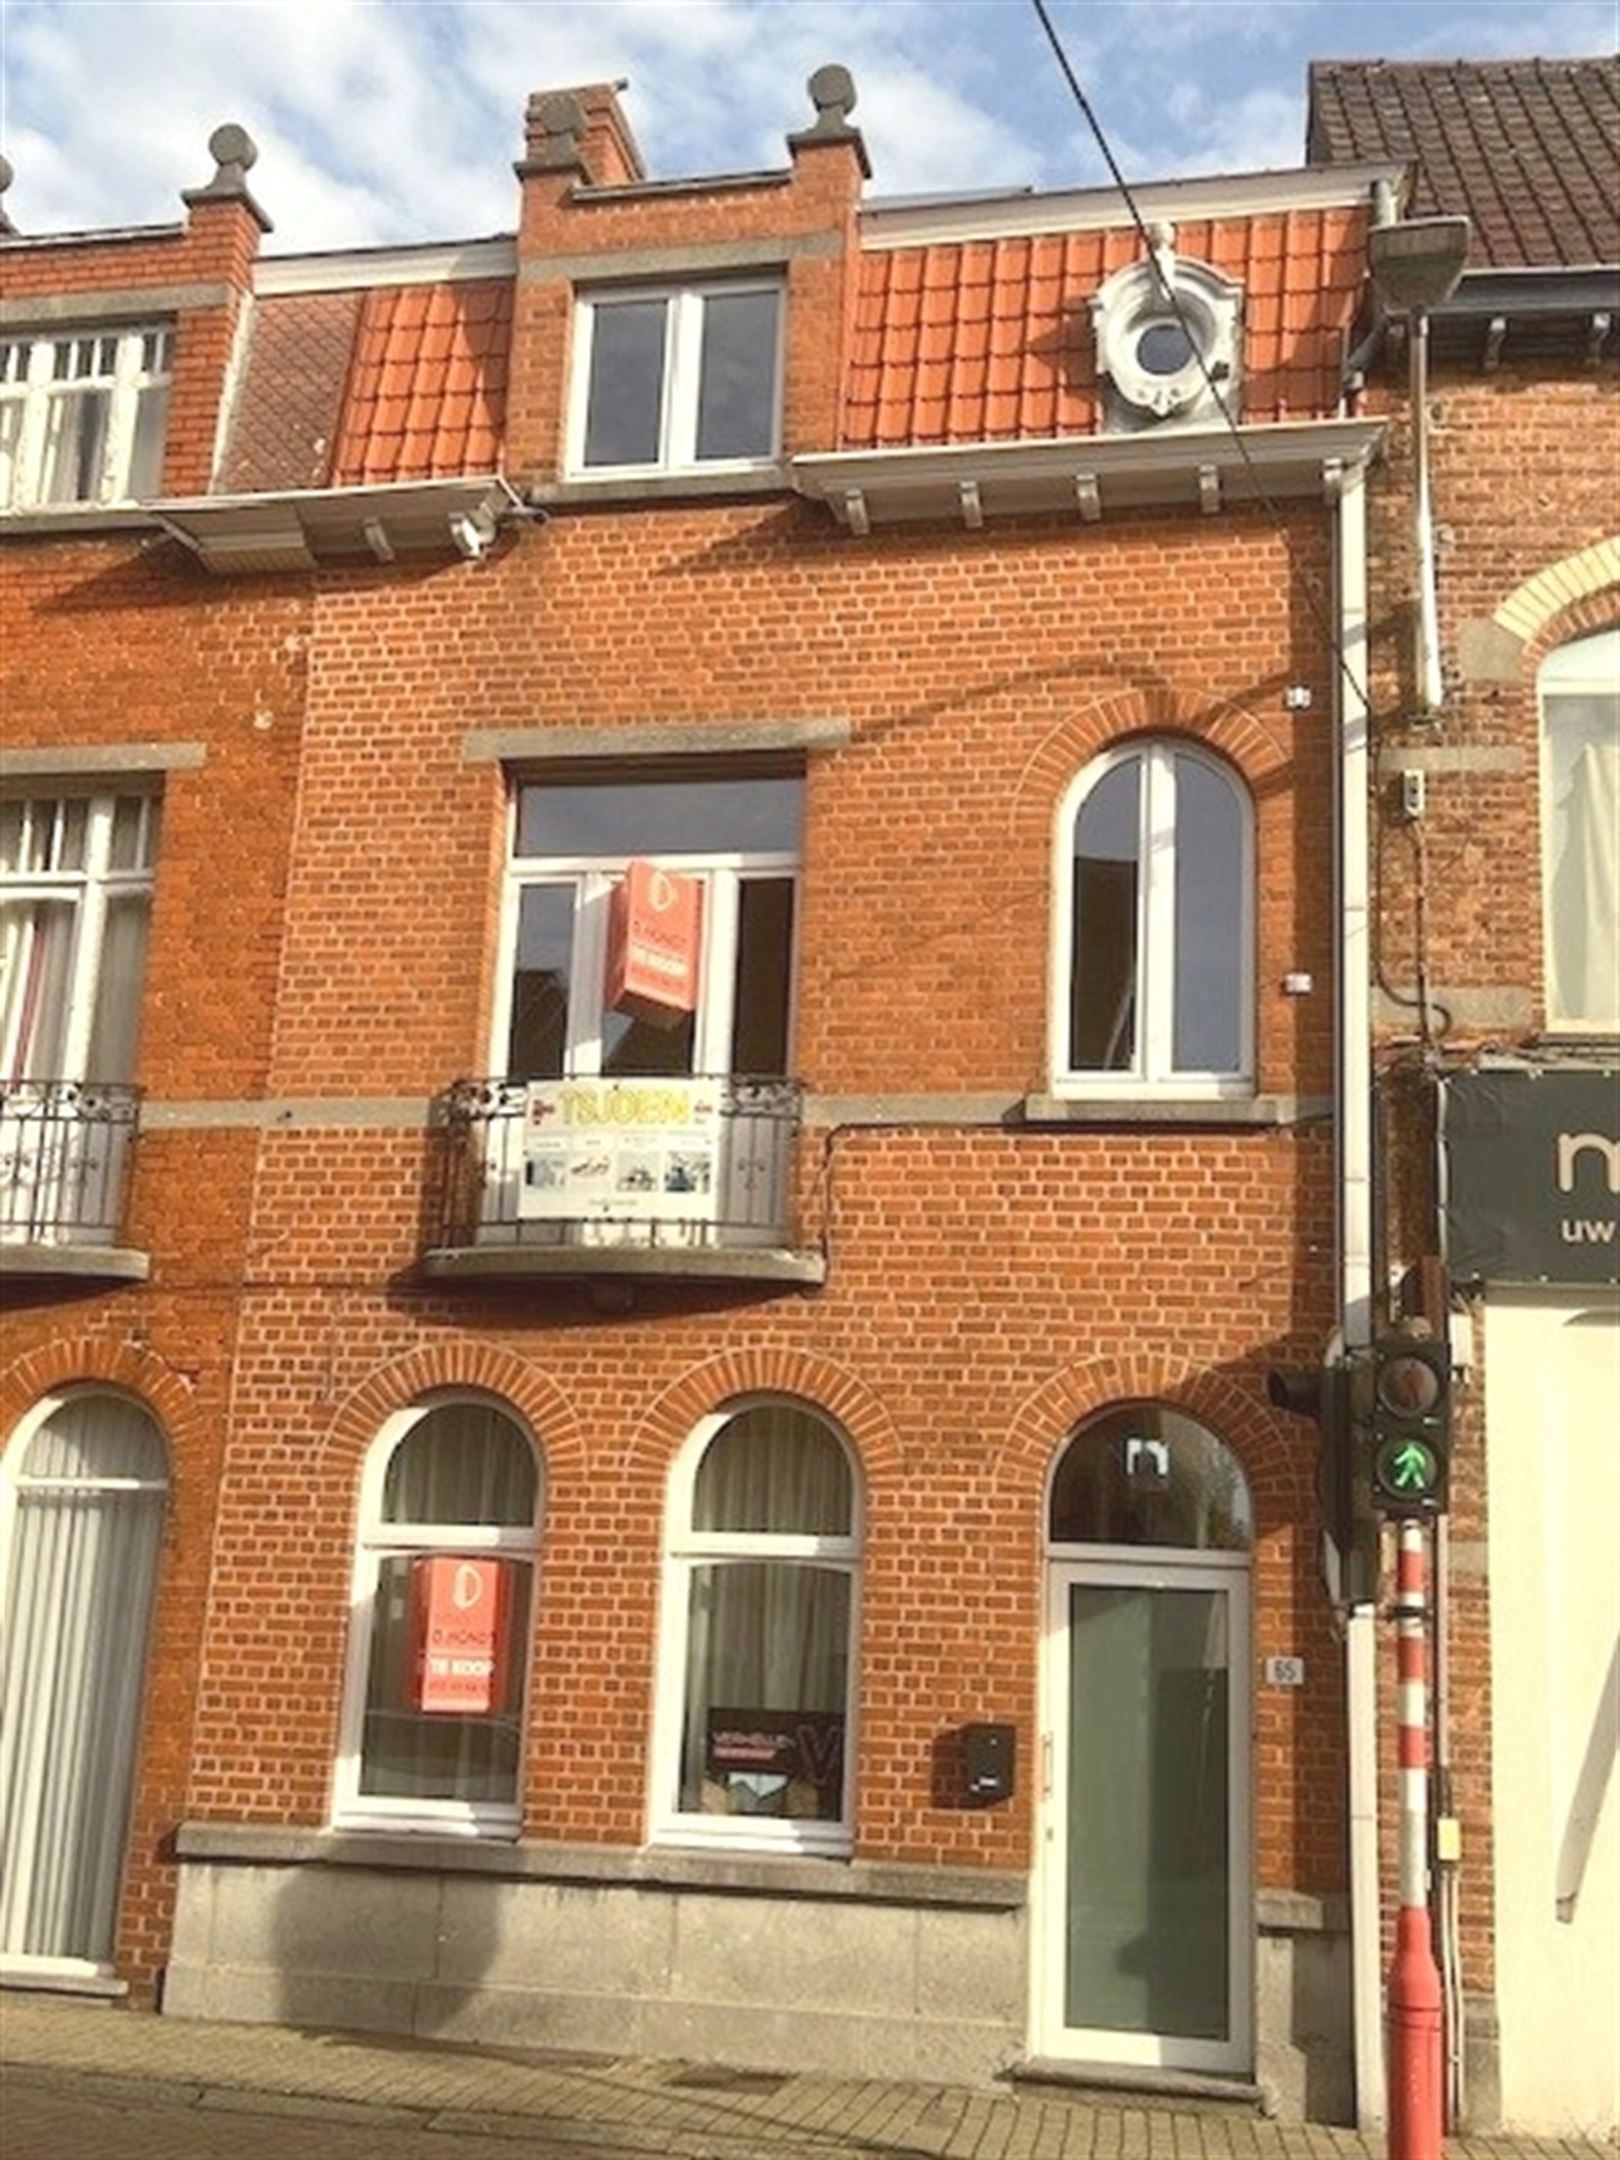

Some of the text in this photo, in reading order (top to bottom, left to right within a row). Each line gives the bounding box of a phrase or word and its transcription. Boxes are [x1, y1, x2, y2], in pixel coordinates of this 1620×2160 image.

[559, 1088, 689, 1125] TSJOEN
[1560, 1219, 1616, 1243] uw
[1274, 1659, 1297, 1682] 65
